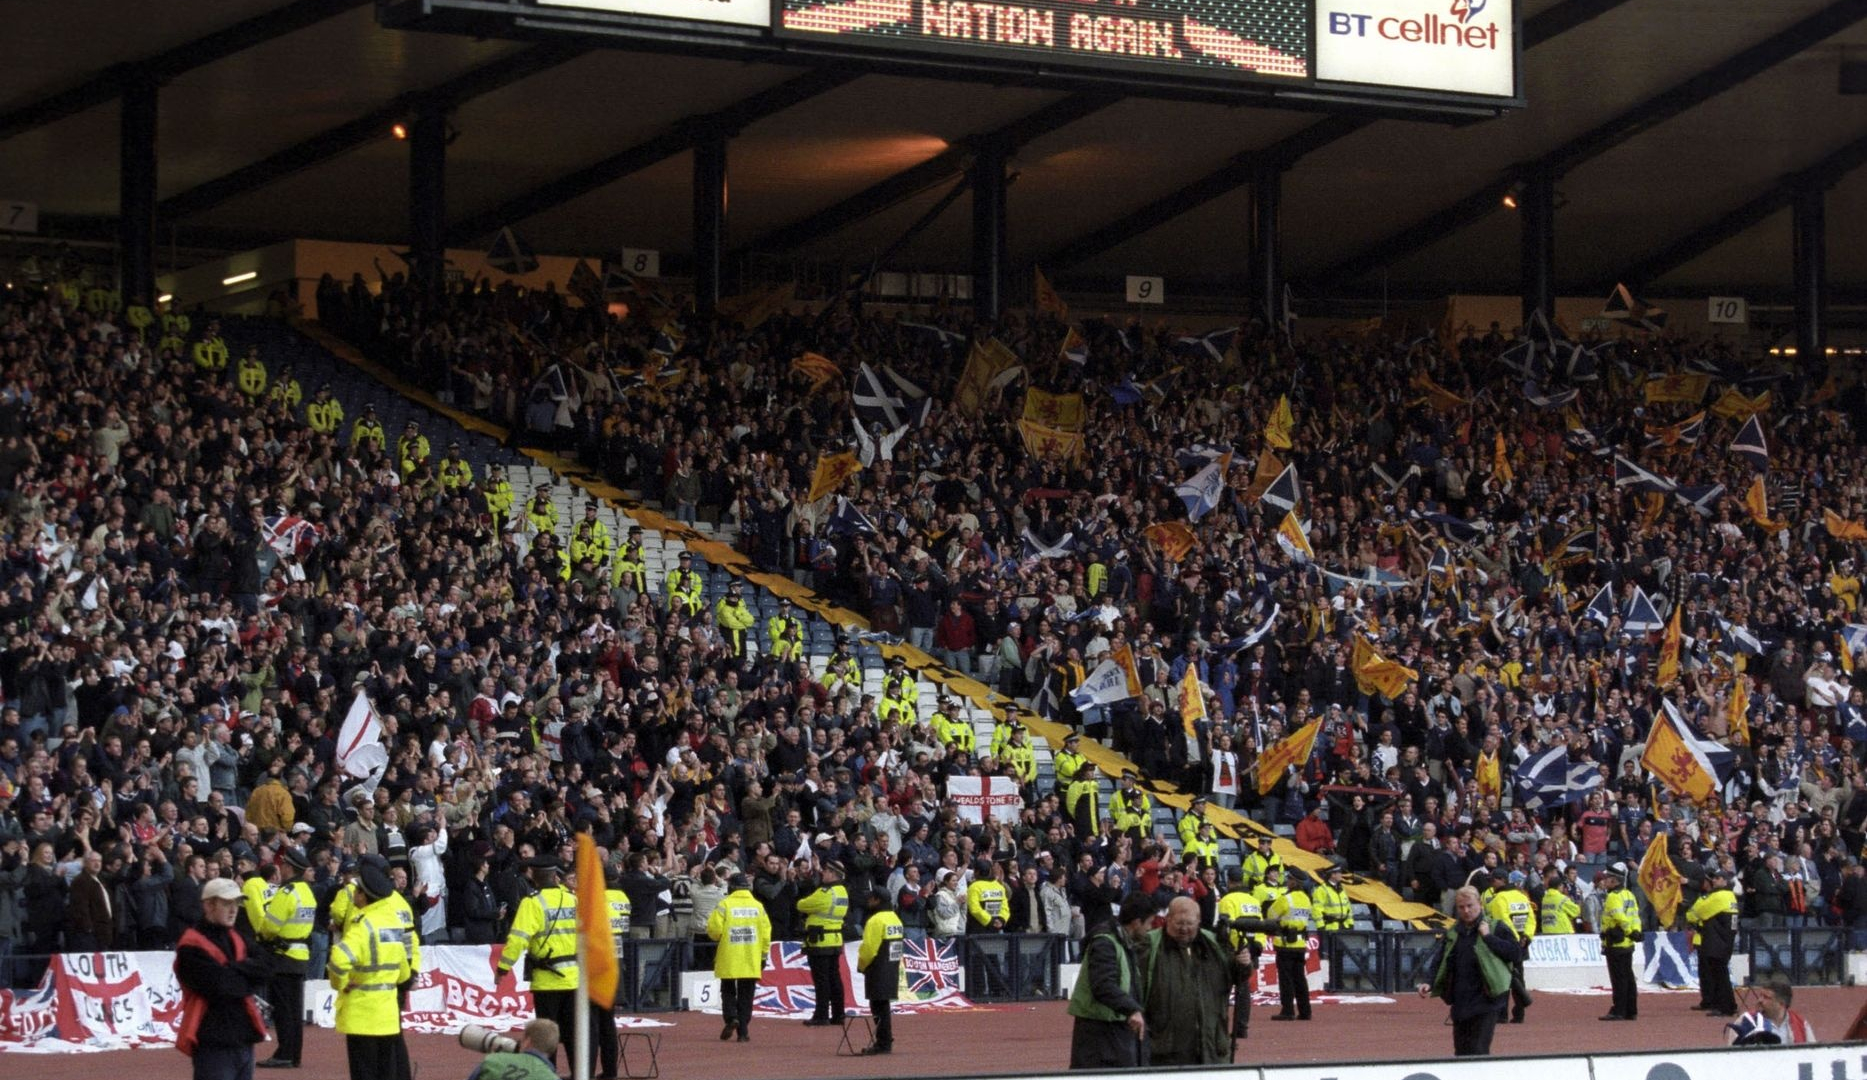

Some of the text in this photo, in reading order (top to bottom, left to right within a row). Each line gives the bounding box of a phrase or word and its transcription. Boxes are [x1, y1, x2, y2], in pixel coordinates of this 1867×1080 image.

[922, 0, 1183, 58] NATION AGAIN.
[1329, 11, 1499, 50] BT cellnet
[10, 205, 25, 225] 7
[634, 253, 648, 272] 8
[1138, 280, 1152, 299] 9
[1715, 300, 1738, 319] 10
[66, 952, 129, 979] LOUTH
[700, 984, 711, 1003] 5
[322, 994, 333, 1014] 4
